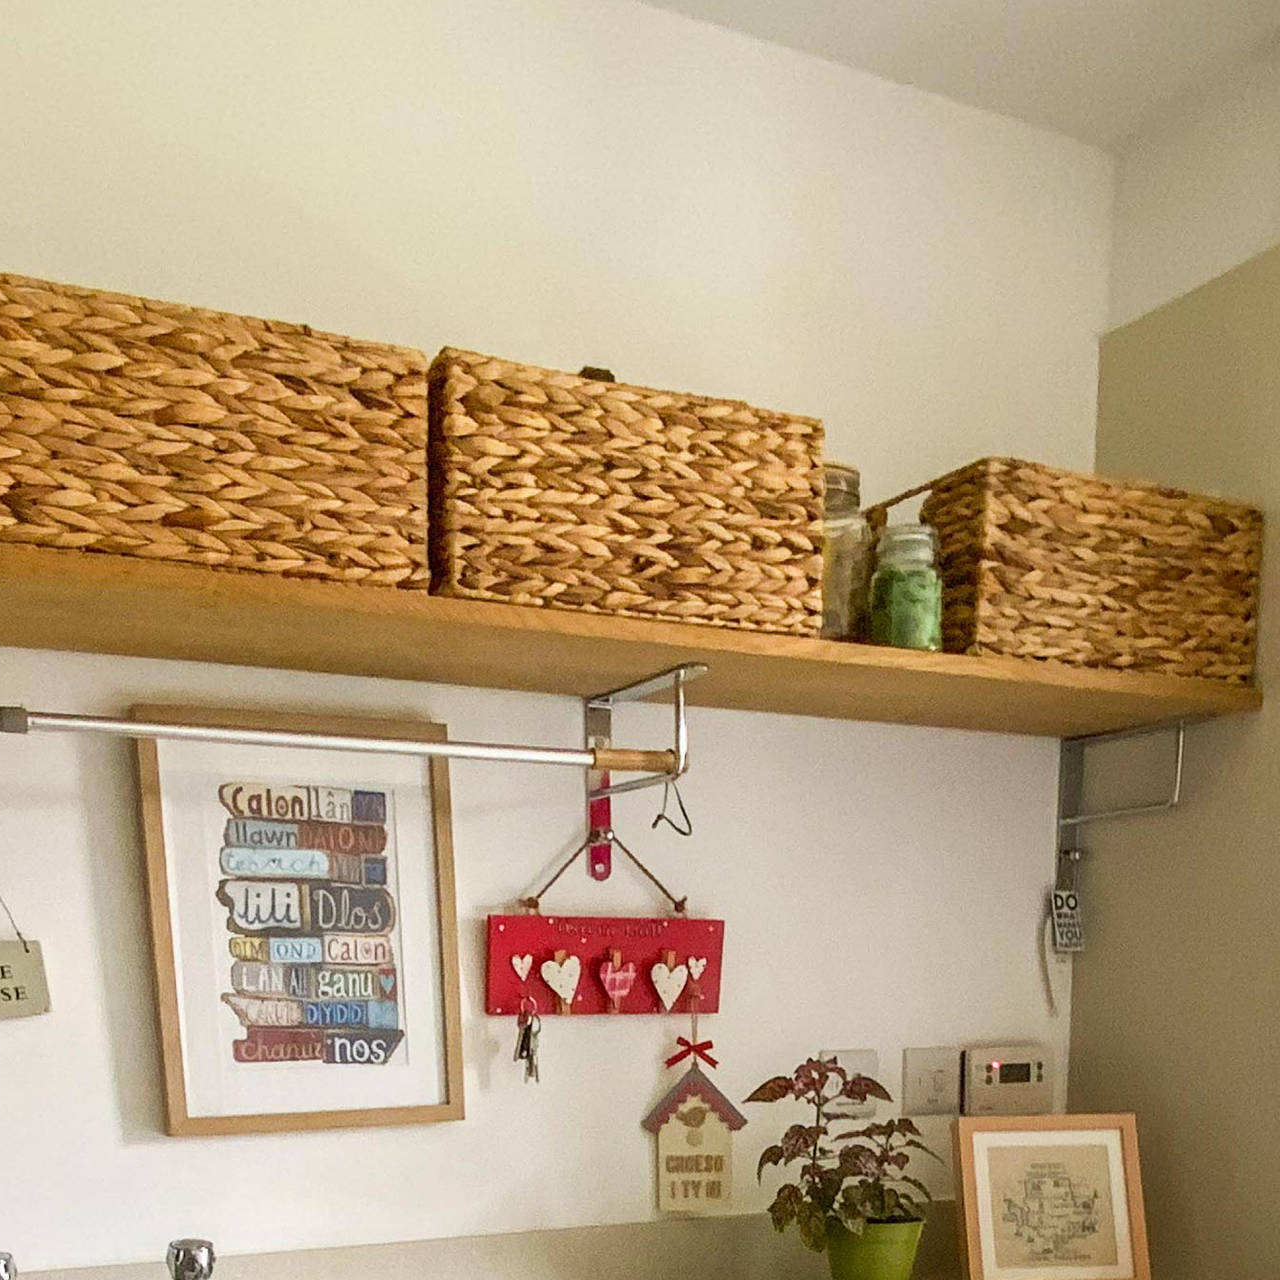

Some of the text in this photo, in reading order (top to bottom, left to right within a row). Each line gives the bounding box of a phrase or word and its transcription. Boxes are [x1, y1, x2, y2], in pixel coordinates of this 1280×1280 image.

[231, 786, 304, 818] Calon
[235, 821, 298, 846] llawn
[237, 887, 298, 924] lili
[1054, 894, 1078, 910] DO
[327, 937, 386, 962] Calon
[317, 970, 373, 999] ganu
[306, 1003, 362, 1025] DYDD
[333, 1036, 388, 1063] nos
